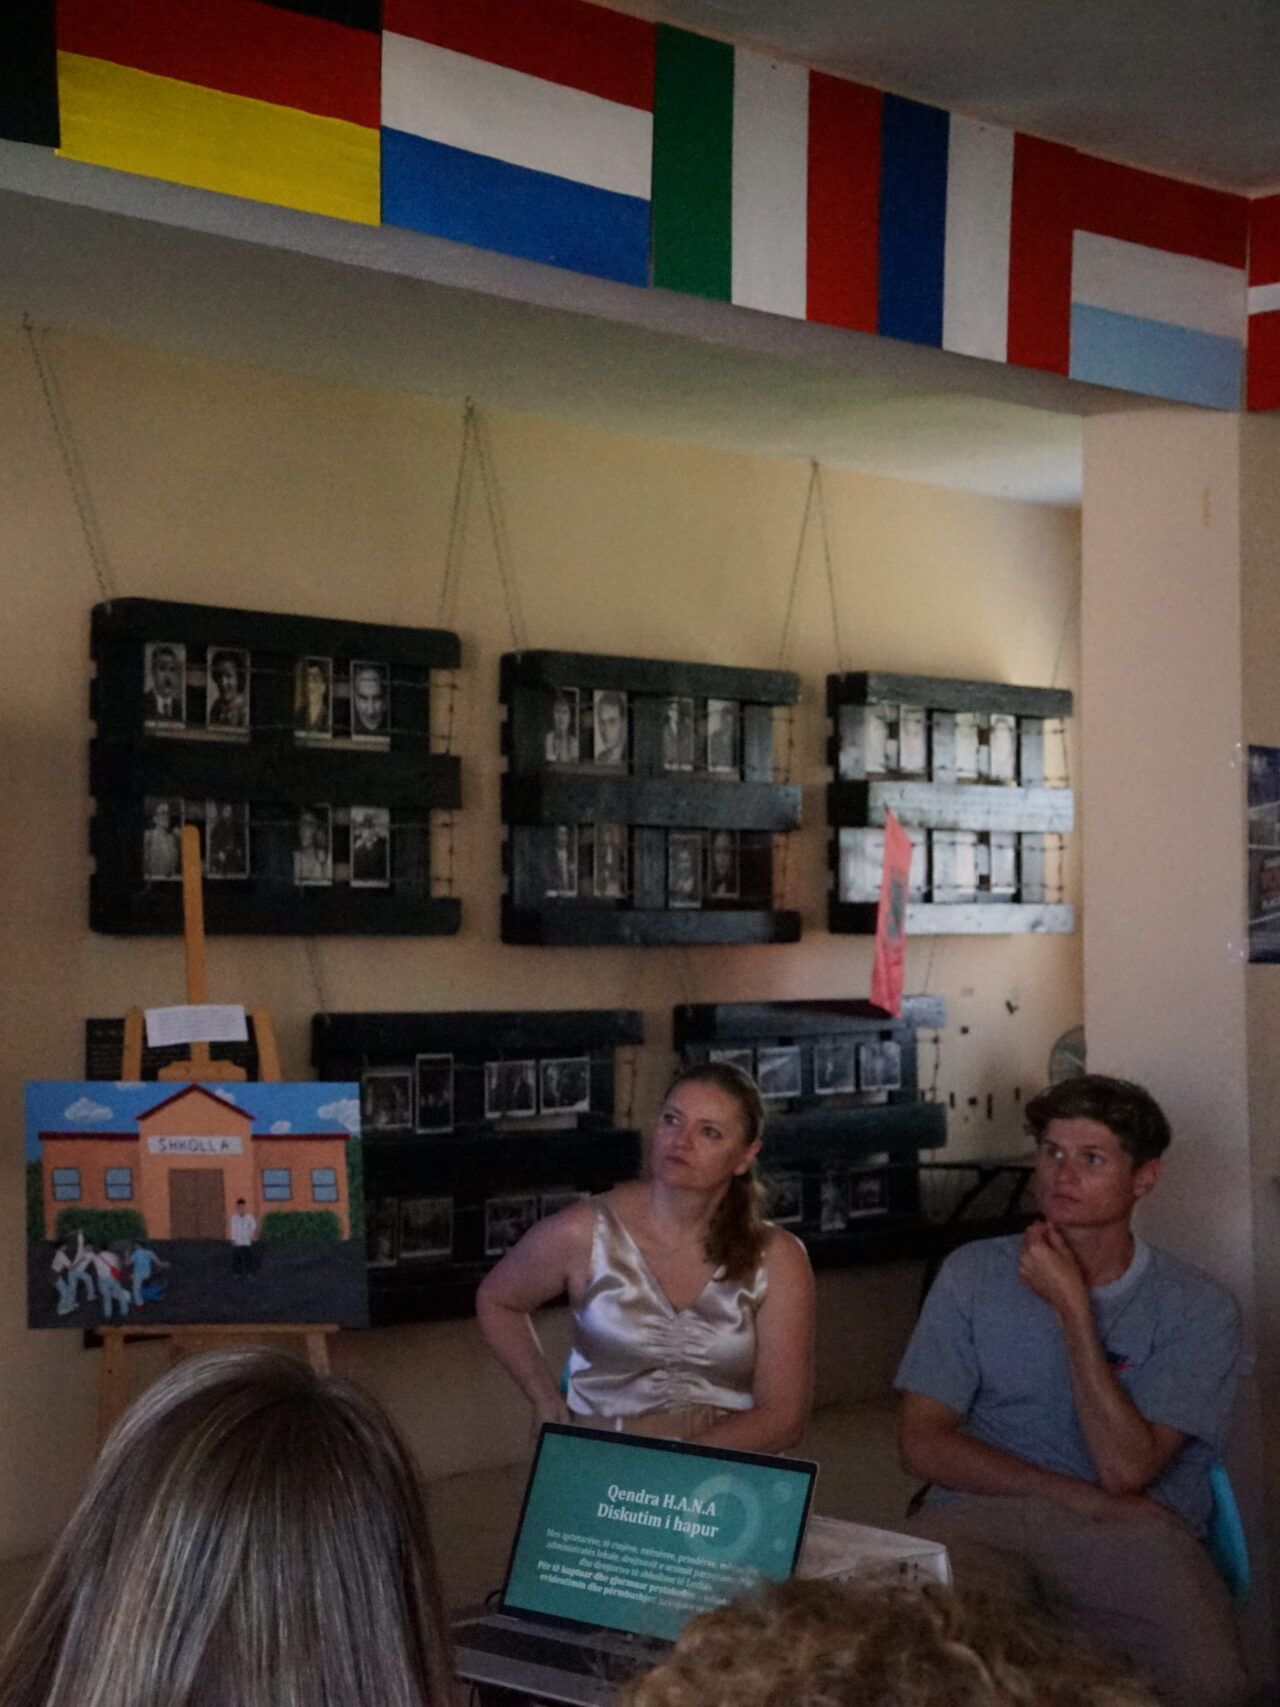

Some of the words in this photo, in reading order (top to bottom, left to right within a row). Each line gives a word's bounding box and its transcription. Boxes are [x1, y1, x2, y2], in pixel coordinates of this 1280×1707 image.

[158, 1137, 231, 1155] SHKOLLA
[608, 1485, 659, 1507] Qendra
[663, 1493, 716, 1516] H.A.N.A
[597, 1503, 662, 1528] Diskutim
[665, 1517, 671, 1529] i
[673, 1516, 719, 1538] hapur
